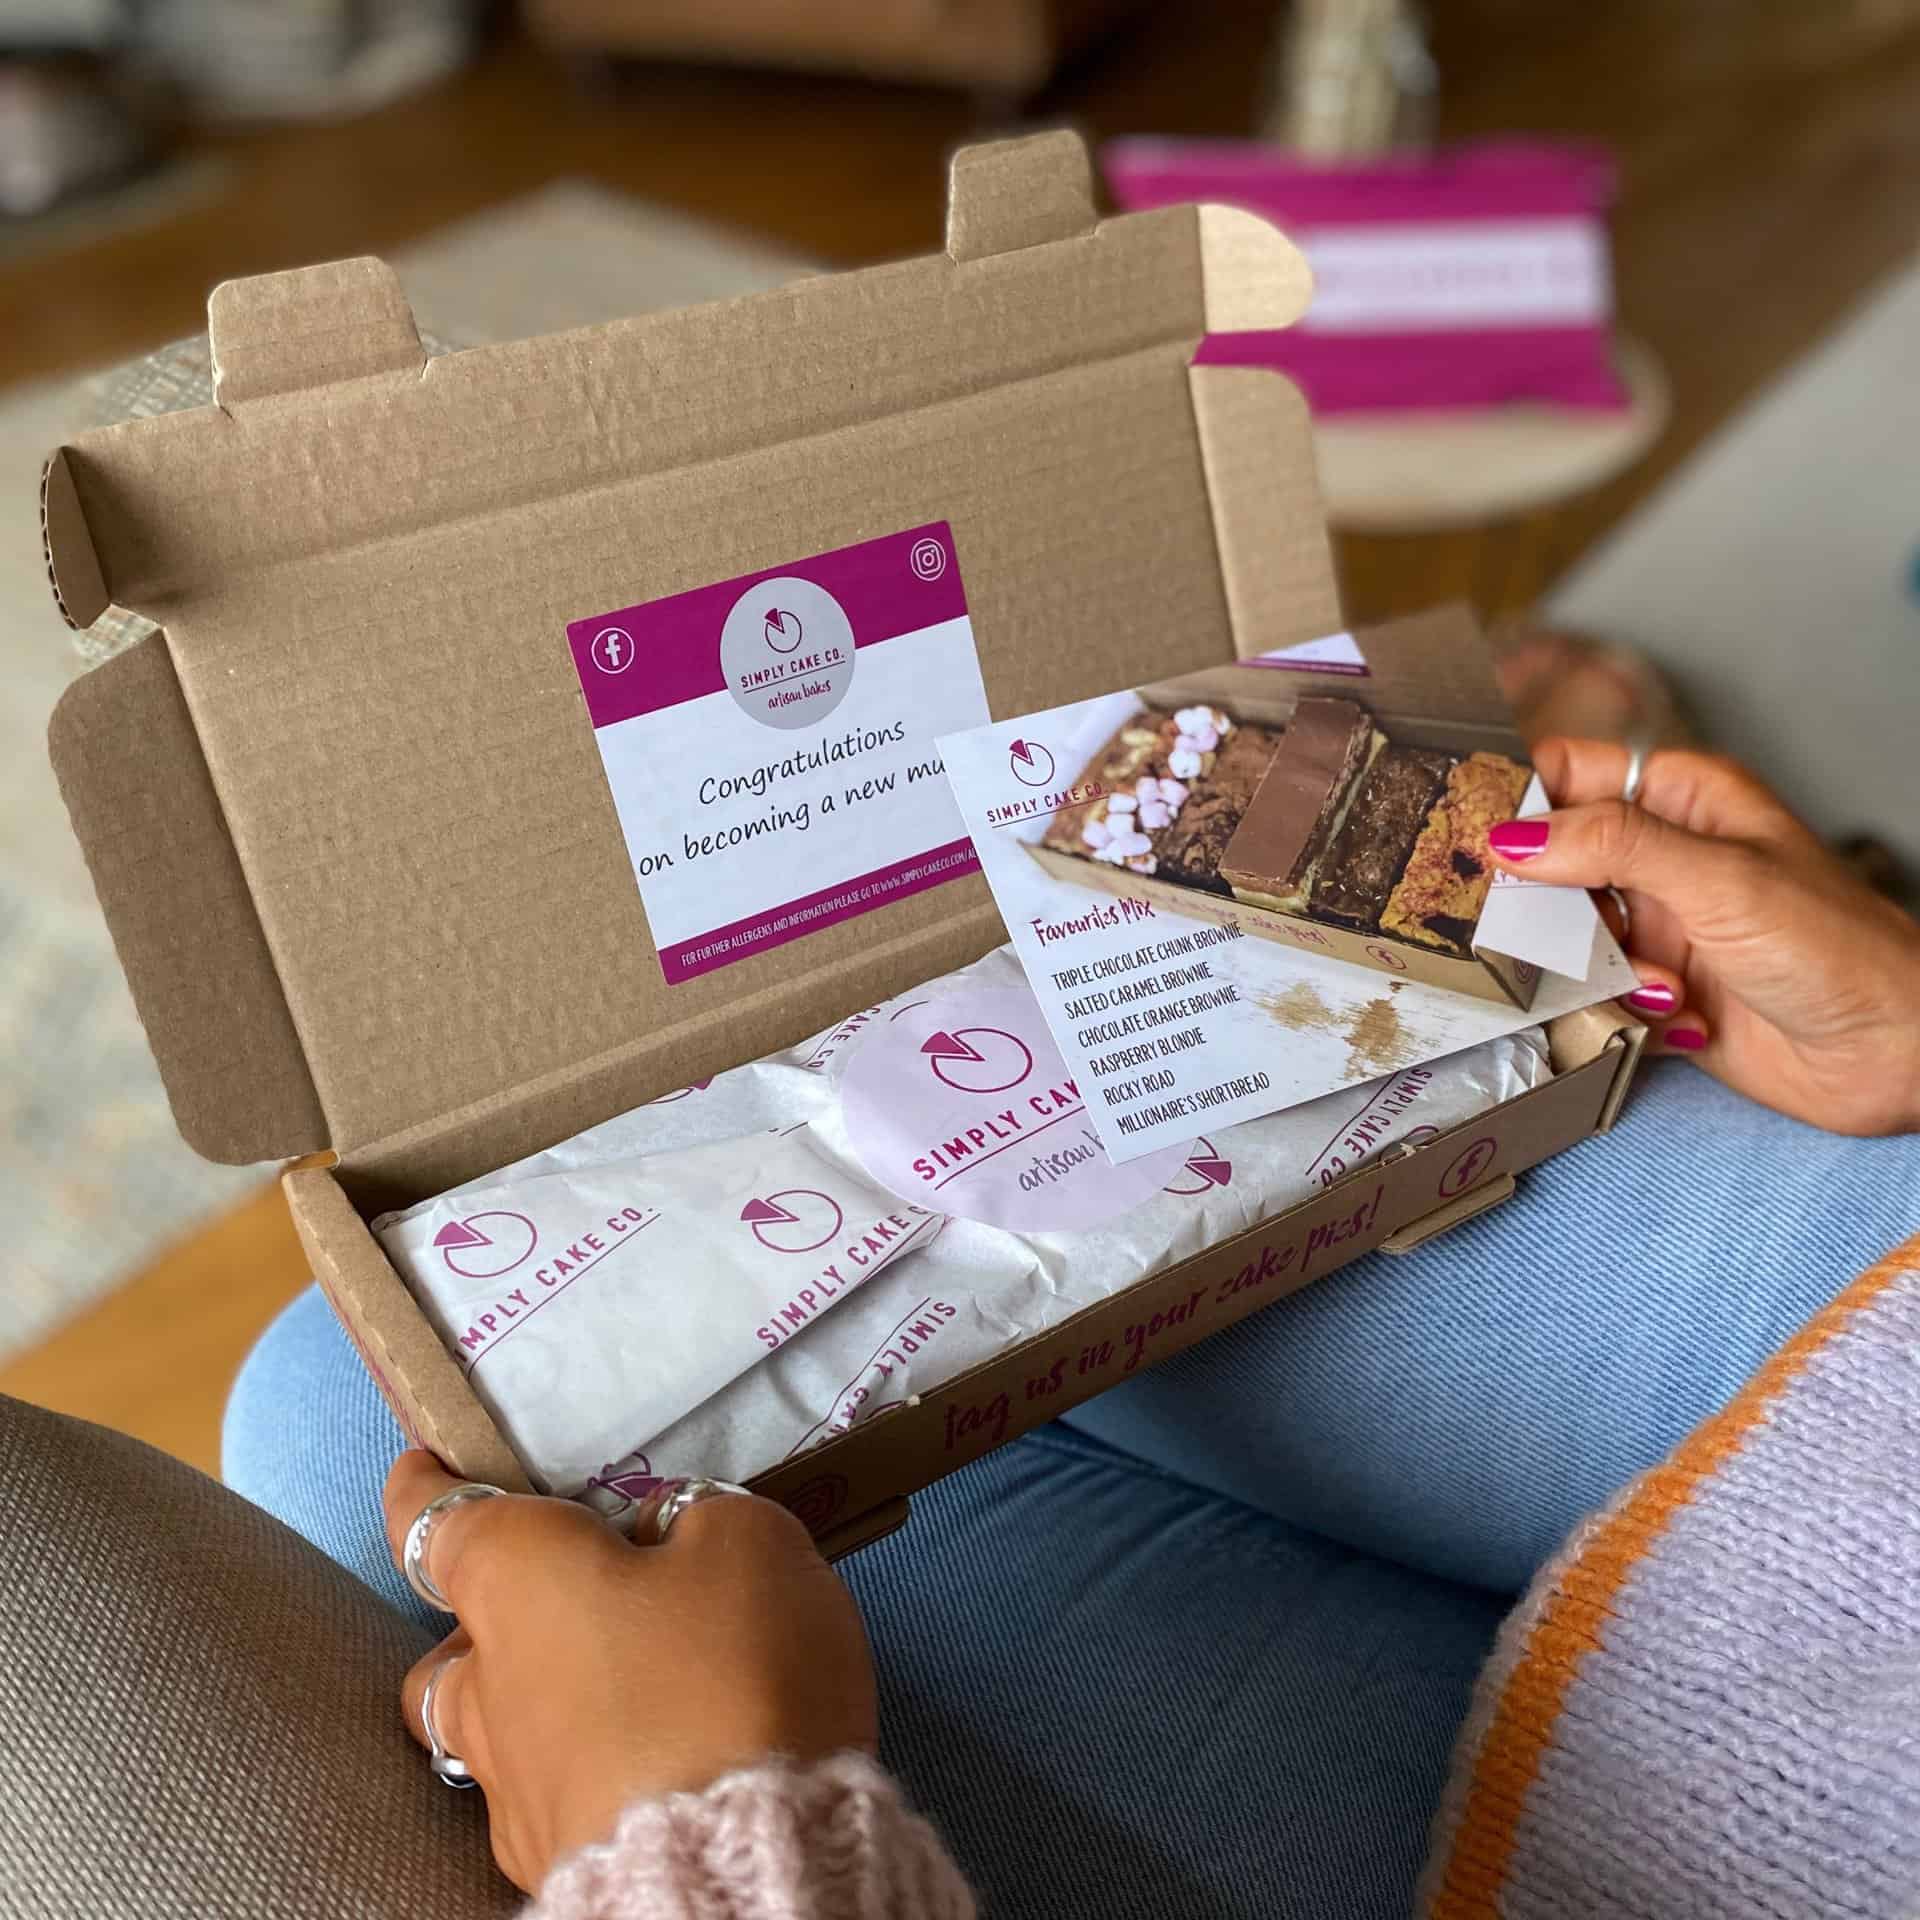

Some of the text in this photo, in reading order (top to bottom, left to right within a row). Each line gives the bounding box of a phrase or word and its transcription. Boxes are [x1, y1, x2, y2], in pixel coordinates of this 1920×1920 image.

[740, 648, 845, 688] SIMPLY CAKE CO.
[768, 680, 831, 709] artisan bakes
[699, 720, 905, 805] Congratulations
[639, 853, 674, 876] on
[683, 803, 810, 860] becoming
[820, 794, 836, 814] a
[844, 773, 896, 805] new
[986, 798, 1037, 823] SIMPLY
[1043, 788, 1081, 808] CAKE
[681, 952, 697, 967] FOR
[697, 939, 731, 961] FURTHER
[731, 923, 773, 948] ALLERGENS
[773, 917, 789, 933] AND
[788, 899, 835, 928] INFORMATION
[834, 890, 862, 910] PLEASE
[861, 887, 871, 900] GO
[871, 883, 881, 897] TO
[1029, 904, 1120, 947] Favourites
[1118, 896, 1156, 924] Mix
[1051, 964, 1094, 992] TRIPLE
[1092, 945, 1159, 980] CHOCOLATE
[1156, 935, 1197, 961] CHUNK
[1193, 920, 1245, 950] BROWNIE
[1064, 961, 1214, 1020] SALTED CARAMEL BROWNIE
[1078, 984, 1241, 1049] CHOCOLATE ORANGE BROWNIE
[1089, 1026, 1207, 1078] RASPBERRY BLONDIE
[1103, 1069, 1176, 1107] ROCKY ROAD
[1115, 1071, 1271, 1136] MILLIONAIRE'S SHORTBREAD
[1380, 1068, 1433, 1116] SIMPLY
[912, 1110, 1022, 1181] SIMPLY
[1018, 1144, 1096, 1191] artisan
[1344, 1115, 1392, 1159] CAKE
[535, 1233, 606, 1287] CAKE
[606, 1207, 654, 1232] CO.
[756, 1264, 846, 1349] SIMPLY
[847, 1214, 911, 1266] CAKE
[1025, 1357, 1070, 1400] us
[1078, 1341, 1116, 1376] in
[1124, 1287, 1209, 1371] your
[1215, 1246, 1300, 1305] cake
[1299, 1184, 1385, 1272] pics!
[873, 1302, 957, 1380] SIMPLY
